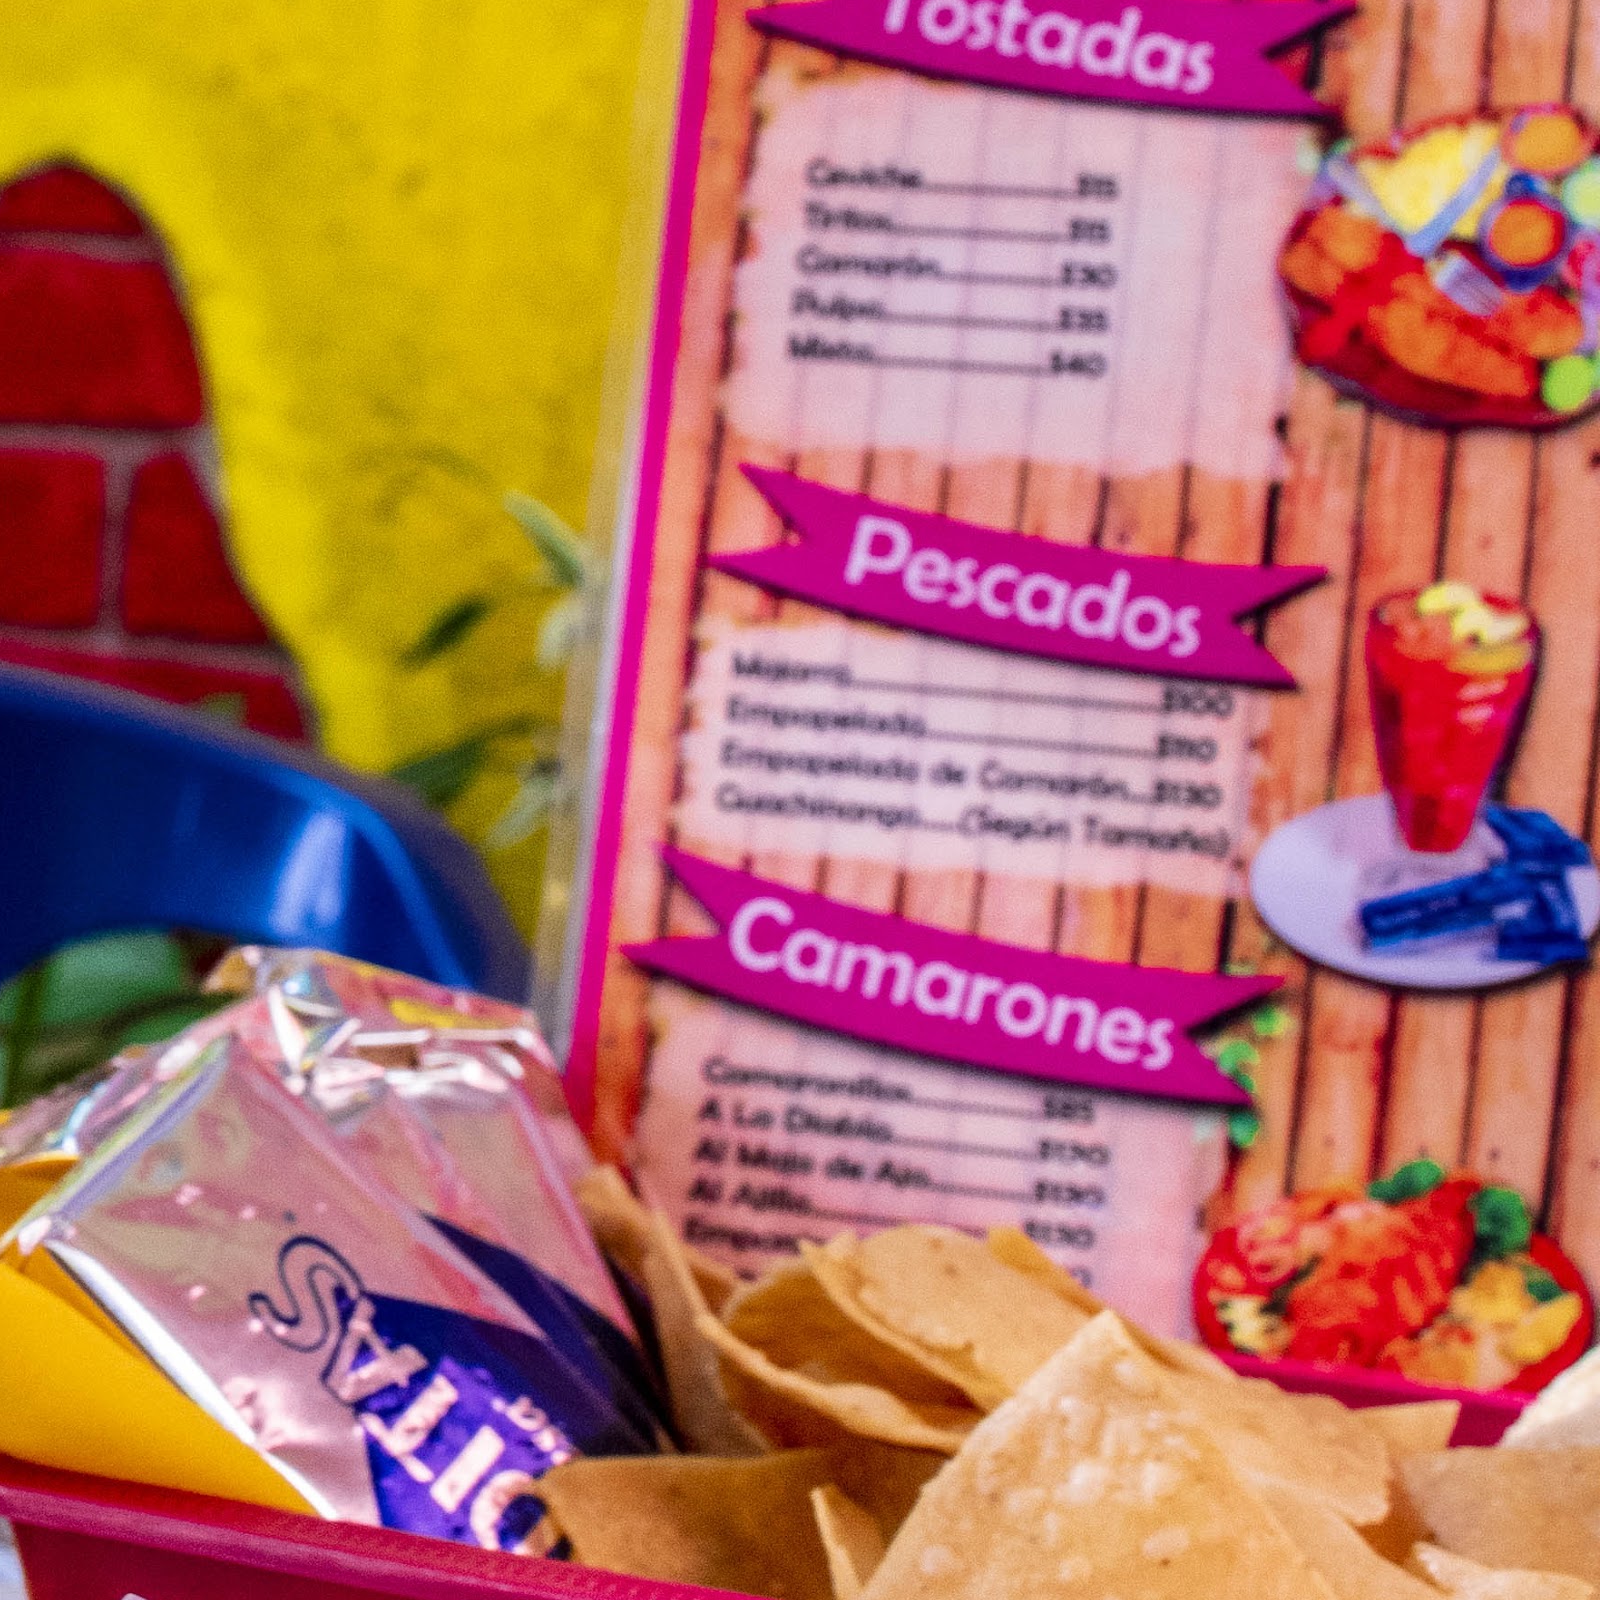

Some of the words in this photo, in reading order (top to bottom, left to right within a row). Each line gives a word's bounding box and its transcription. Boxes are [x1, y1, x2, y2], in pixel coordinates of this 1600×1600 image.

[844, 514, 1203, 659] Pescados
[930, 761, 967, 787] de
[729, 898, 1174, 1073] Camarones
